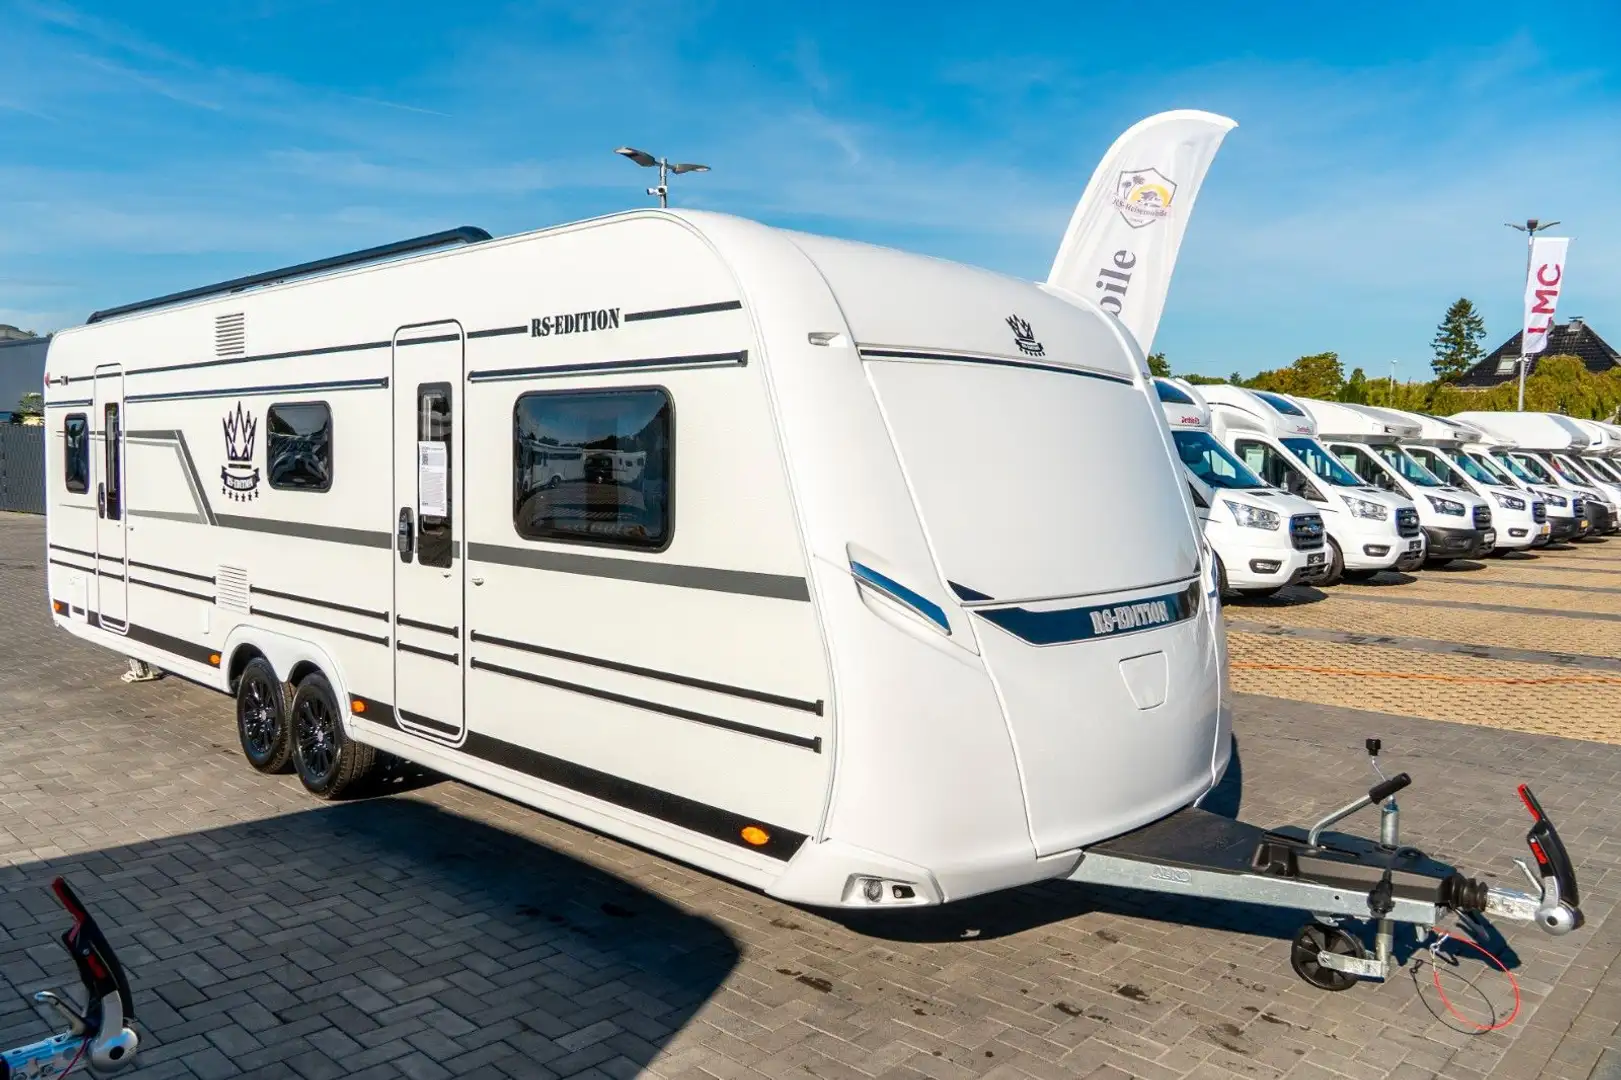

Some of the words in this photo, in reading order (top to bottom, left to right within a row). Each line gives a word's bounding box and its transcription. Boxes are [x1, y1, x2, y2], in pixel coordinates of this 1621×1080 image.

[1527, 263, 1561, 333] LMC
[531, 307, 621, 338] RS-EDITION
[1089, 600, 1169, 634] RS-EDITION
